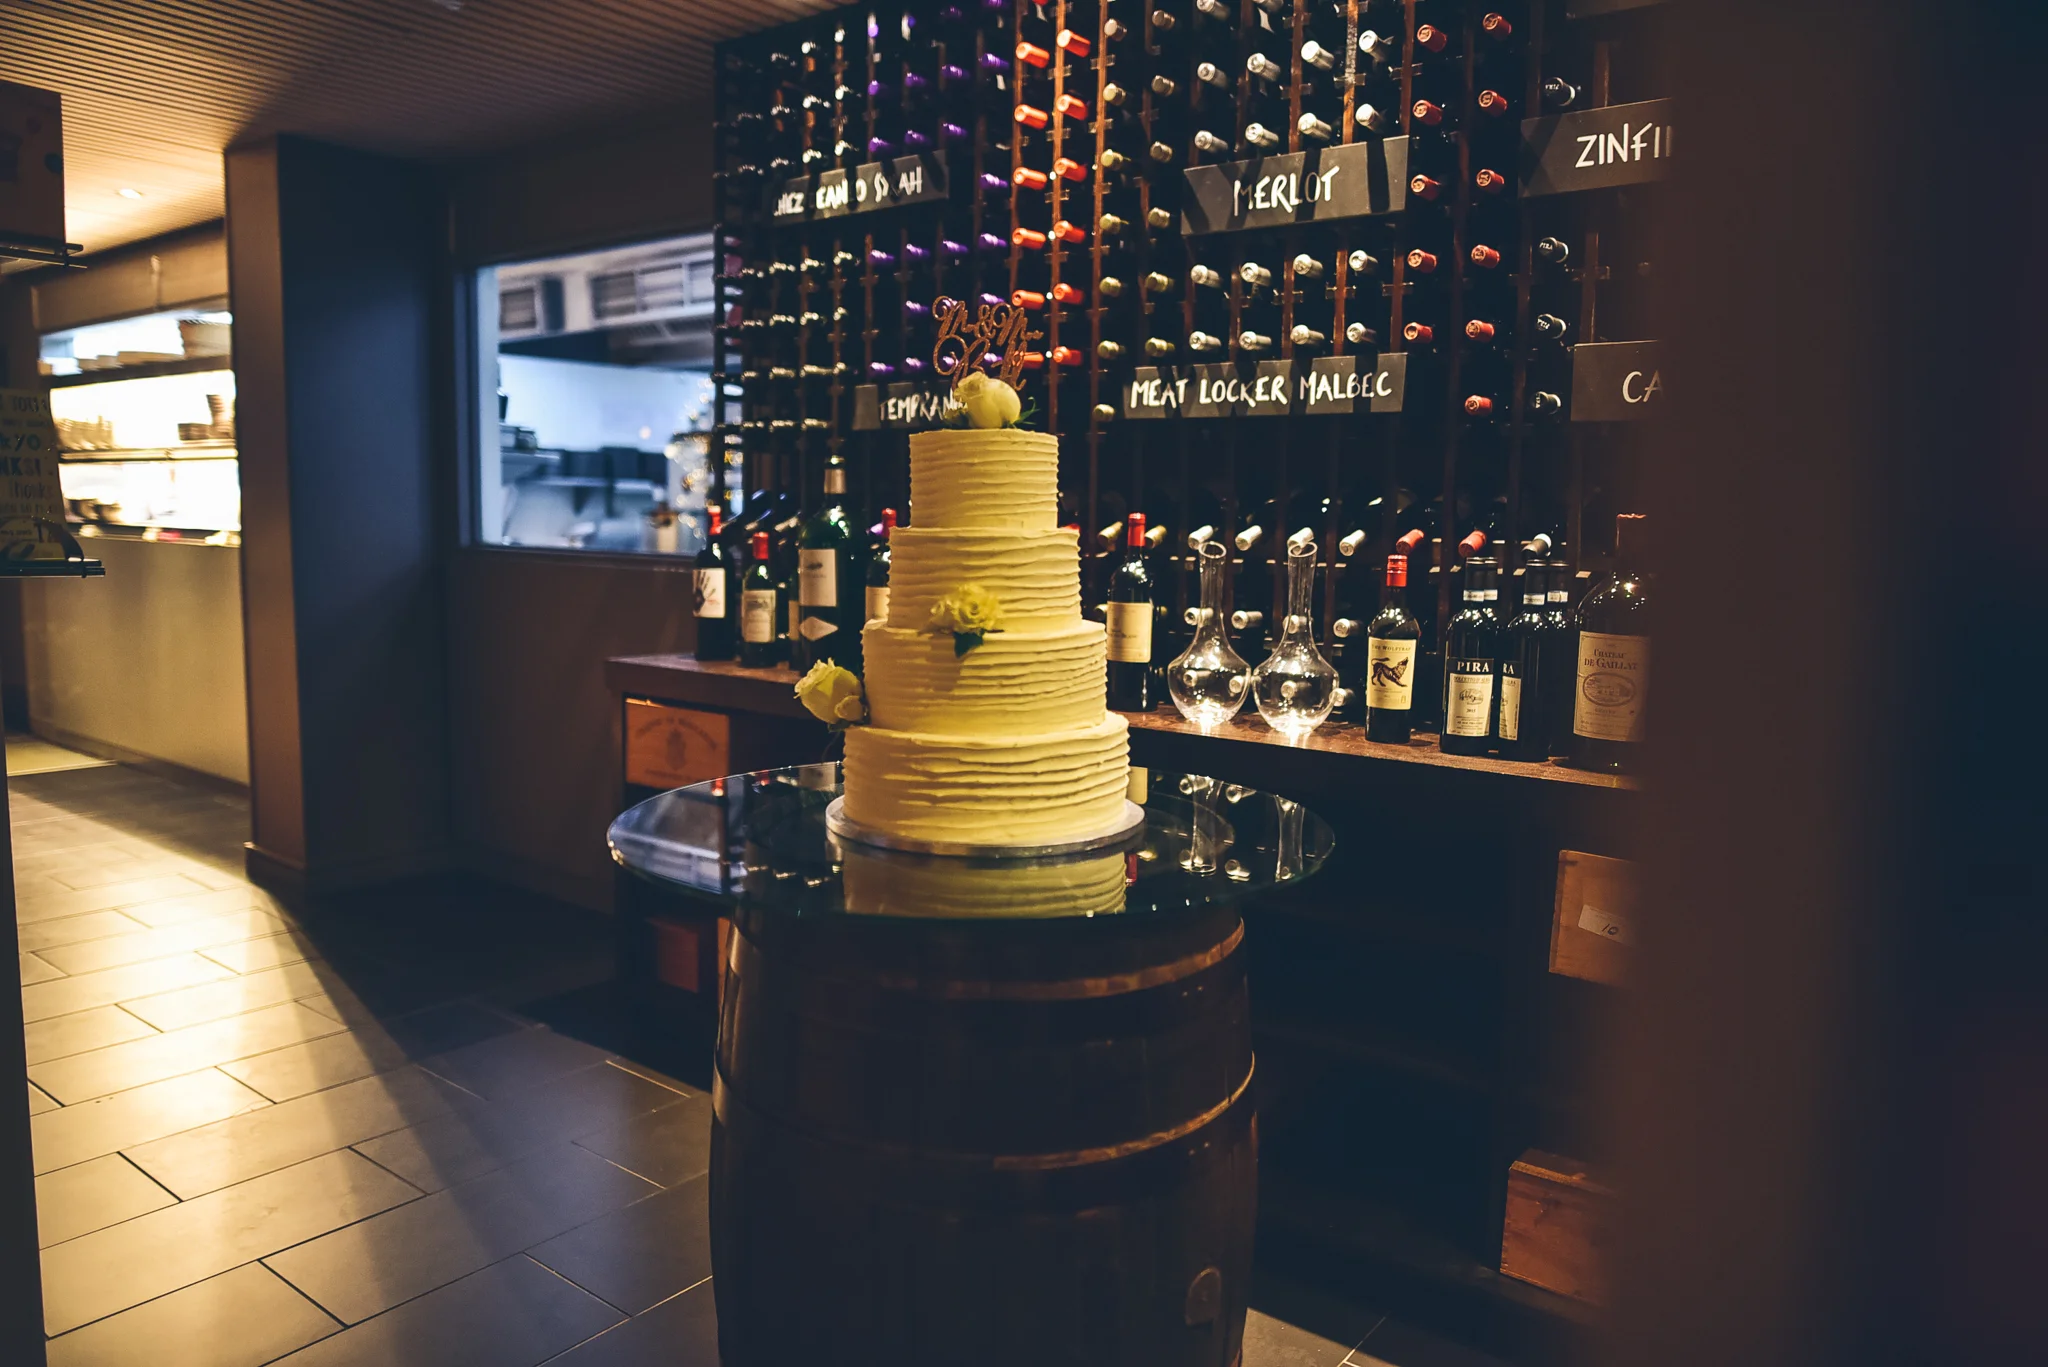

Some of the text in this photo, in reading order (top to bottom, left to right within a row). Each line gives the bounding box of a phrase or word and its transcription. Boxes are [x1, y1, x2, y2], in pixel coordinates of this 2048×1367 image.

[1233, 165, 1340, 217] MERLOT
[1130, 370, 1392, 409] MEAT LOCKER MALBEC
[1457, 661, 1489, 673] PIRA
